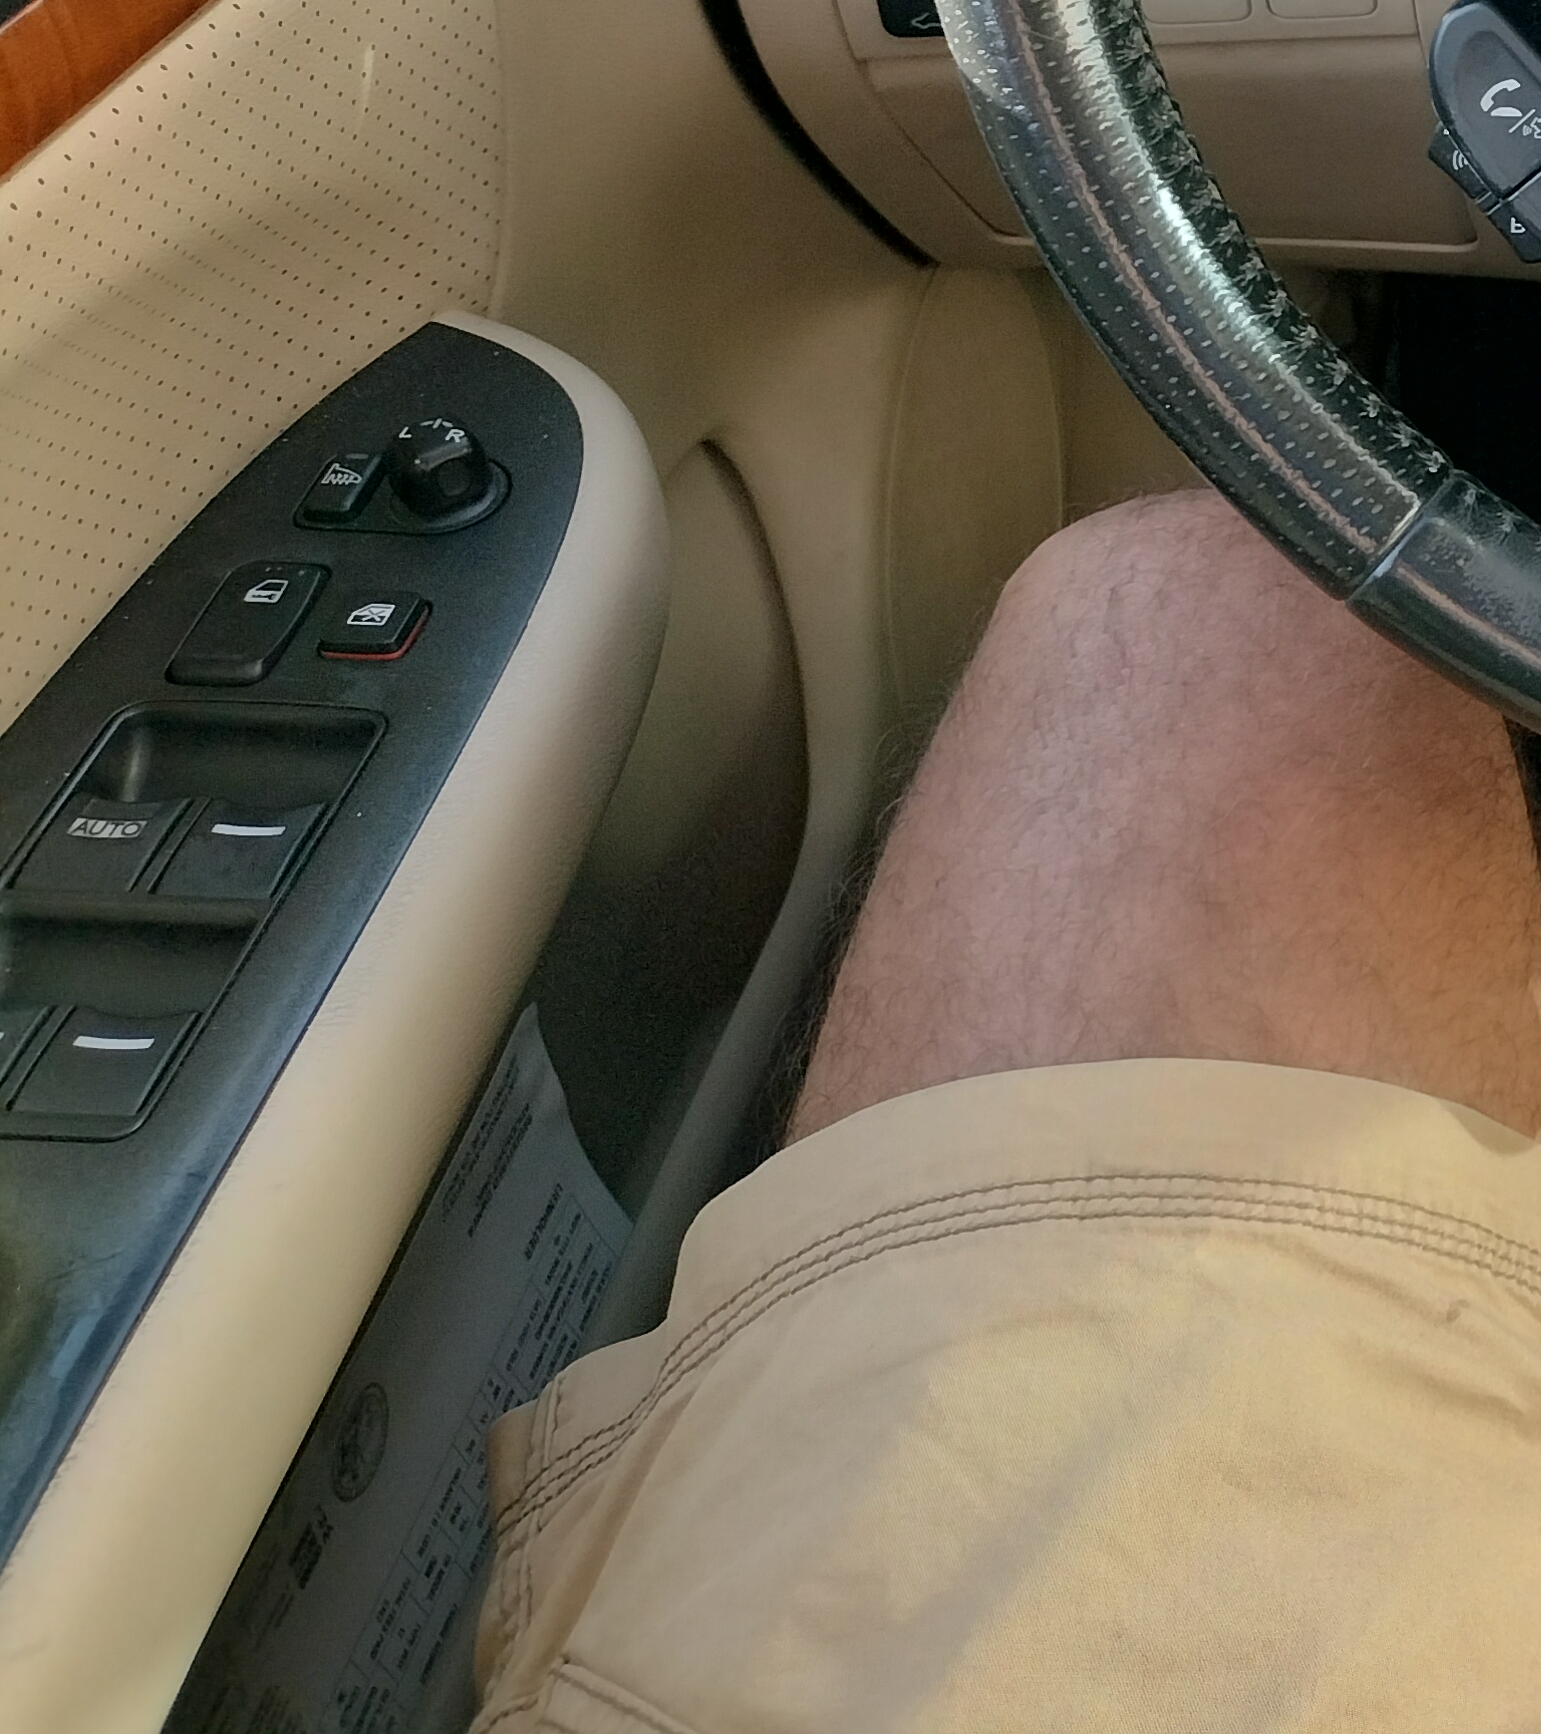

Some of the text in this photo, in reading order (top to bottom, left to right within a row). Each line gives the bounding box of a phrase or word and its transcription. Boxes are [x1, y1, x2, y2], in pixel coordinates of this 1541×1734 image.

[398, 427, 412, 439] L
[445, 428, 466, 442] R
[71, 819, 144, 838] AUTO
